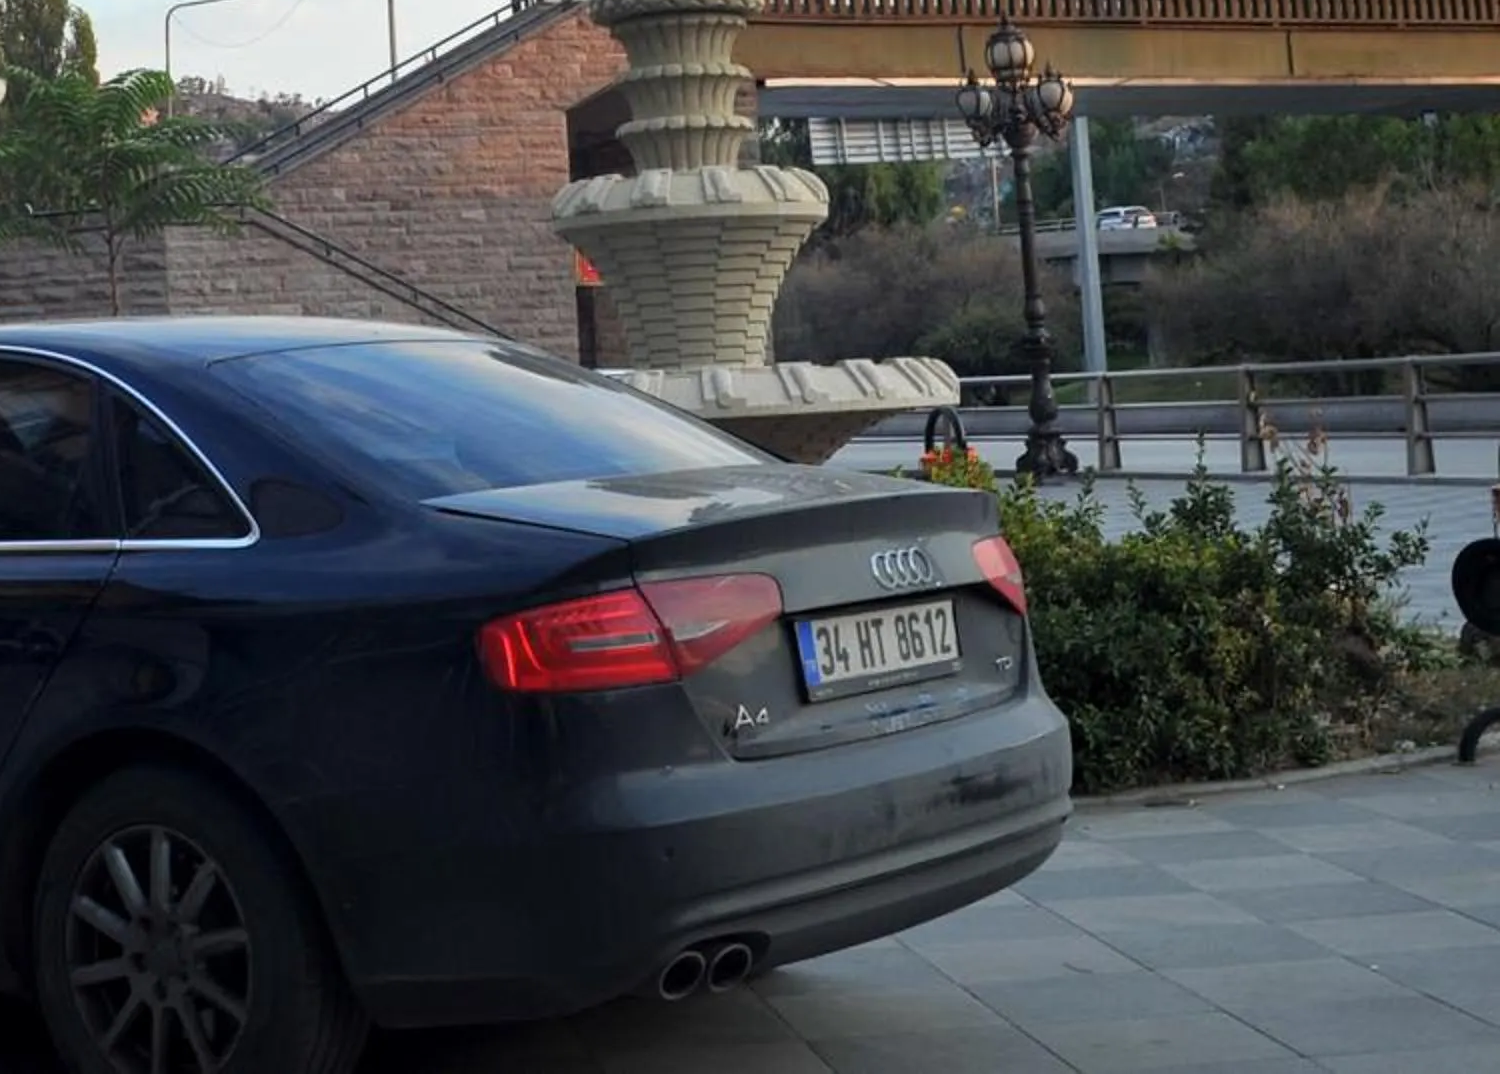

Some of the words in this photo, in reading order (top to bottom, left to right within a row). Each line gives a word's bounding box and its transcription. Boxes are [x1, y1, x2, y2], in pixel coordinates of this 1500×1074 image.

[816, 623, 850, 676] 34
[855, 617, 887, 670] HT
[894, 607, 952, 662] 8612
[734, 704, 769, 730] A4
